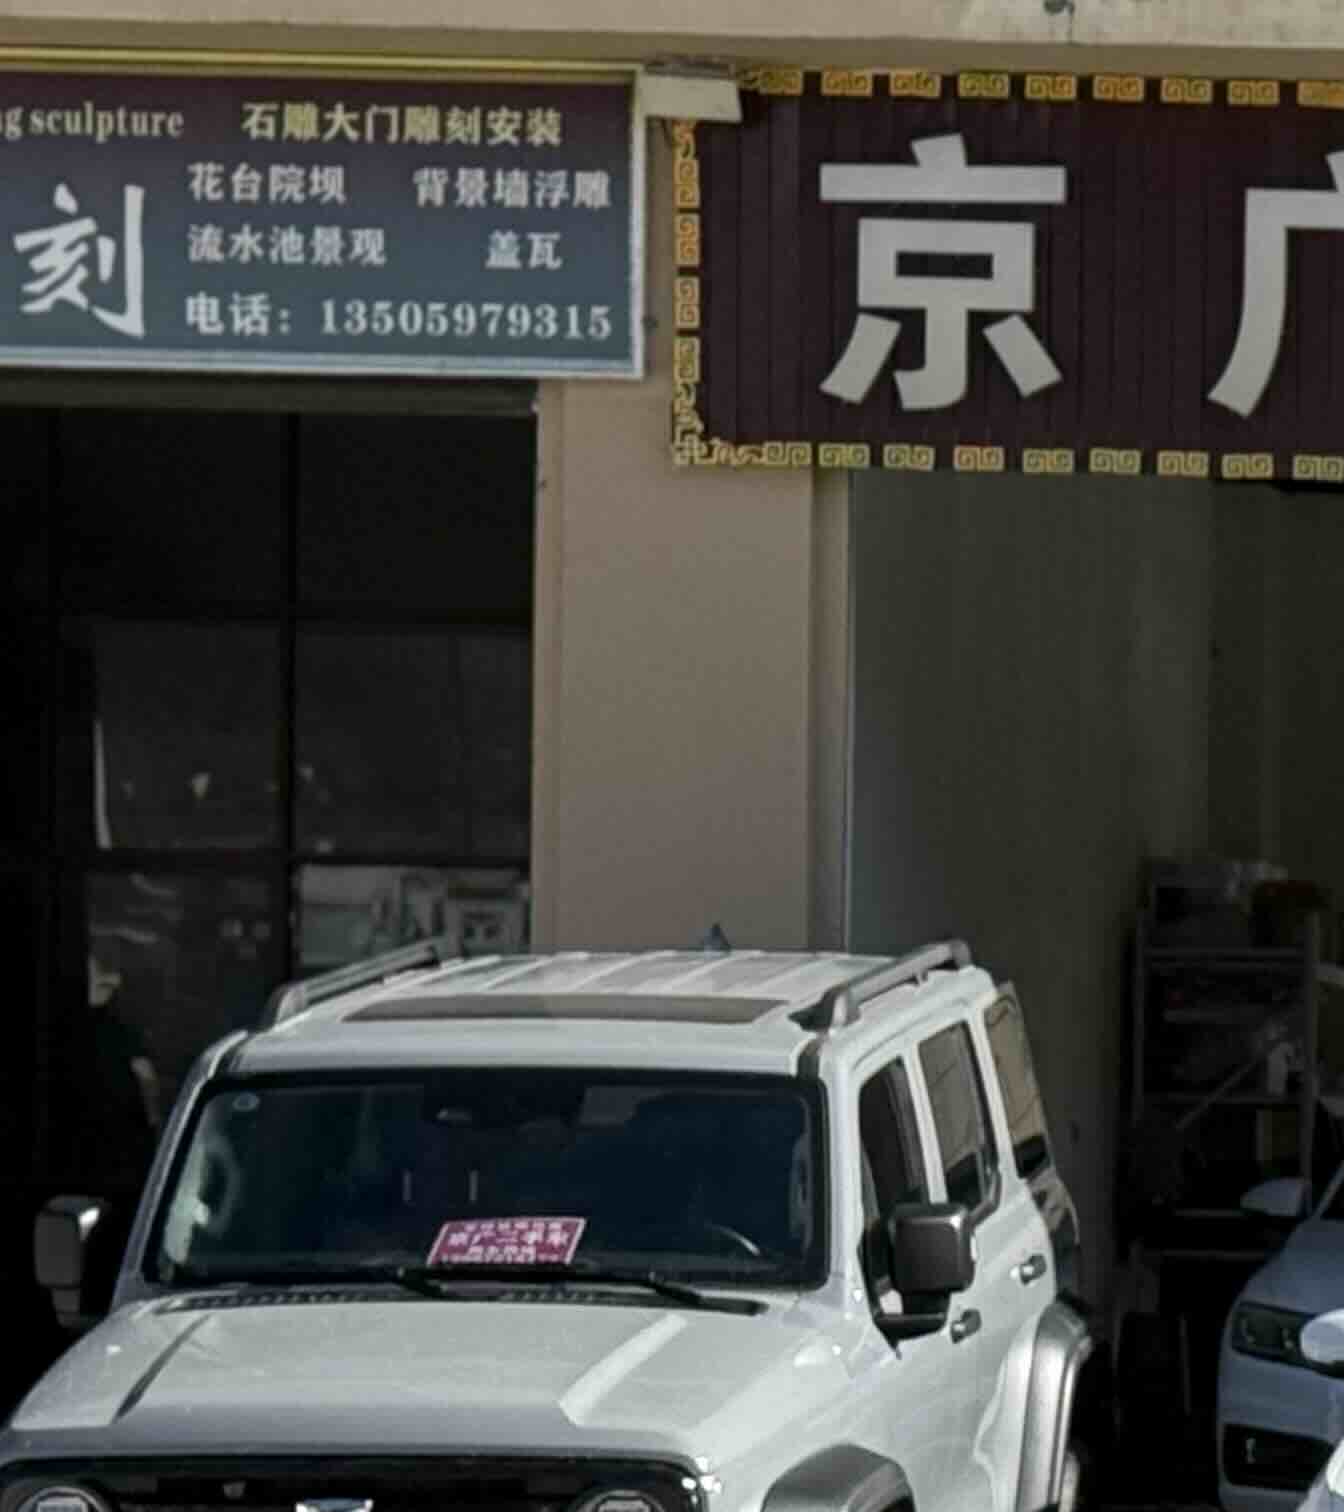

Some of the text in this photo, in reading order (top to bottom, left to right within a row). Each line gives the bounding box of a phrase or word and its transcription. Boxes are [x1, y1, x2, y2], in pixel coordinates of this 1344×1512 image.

[0, 101, 184, 144] g sculpture
[241, 101, 563, 147] 石雕大门雕刻安装
[187, 161, 611, 209] 花台院坝 背景墙浮雕
[12, 182, 146, 339] 刻
[484, 228, 563, 270] 盖瓦
[320, 298, 612, 341] 13505979315
